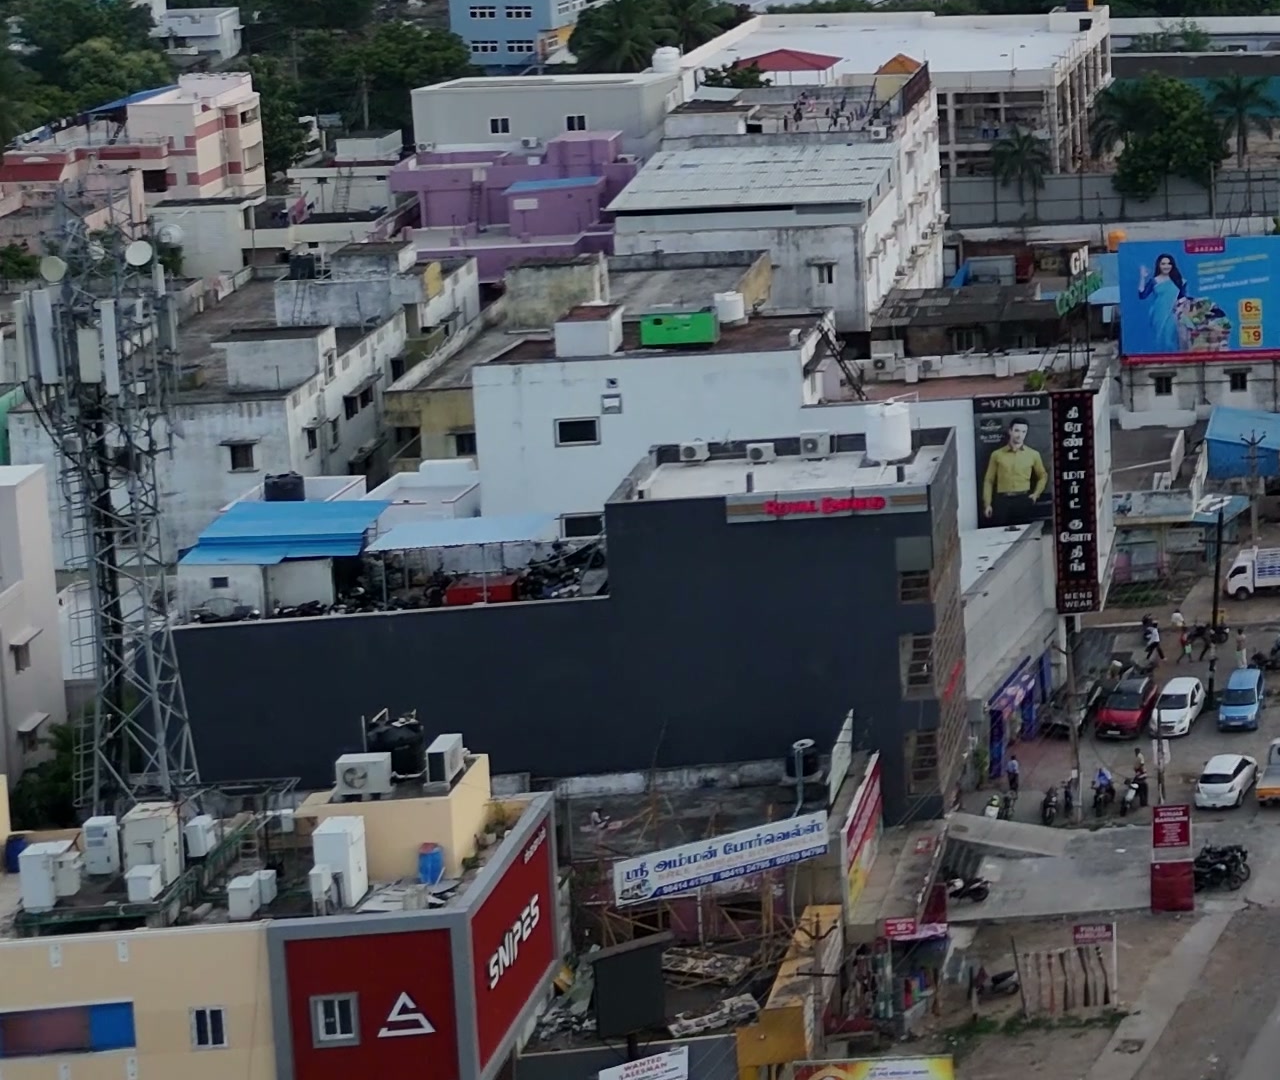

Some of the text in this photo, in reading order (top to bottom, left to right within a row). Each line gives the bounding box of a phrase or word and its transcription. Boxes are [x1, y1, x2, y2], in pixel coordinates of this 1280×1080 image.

[1070, 245, 1089, 275] GM
[990, 397, 1041, 409] VENFIELD
[1064, 591, 1093, 600] MENS
[1065, 599, 1093, 608] WEAR
[654, 846, 719, 872] அம்மன்
[489, 893, 540, 989] SNIPES
[623, 1055, 662, 1071] WANTED
